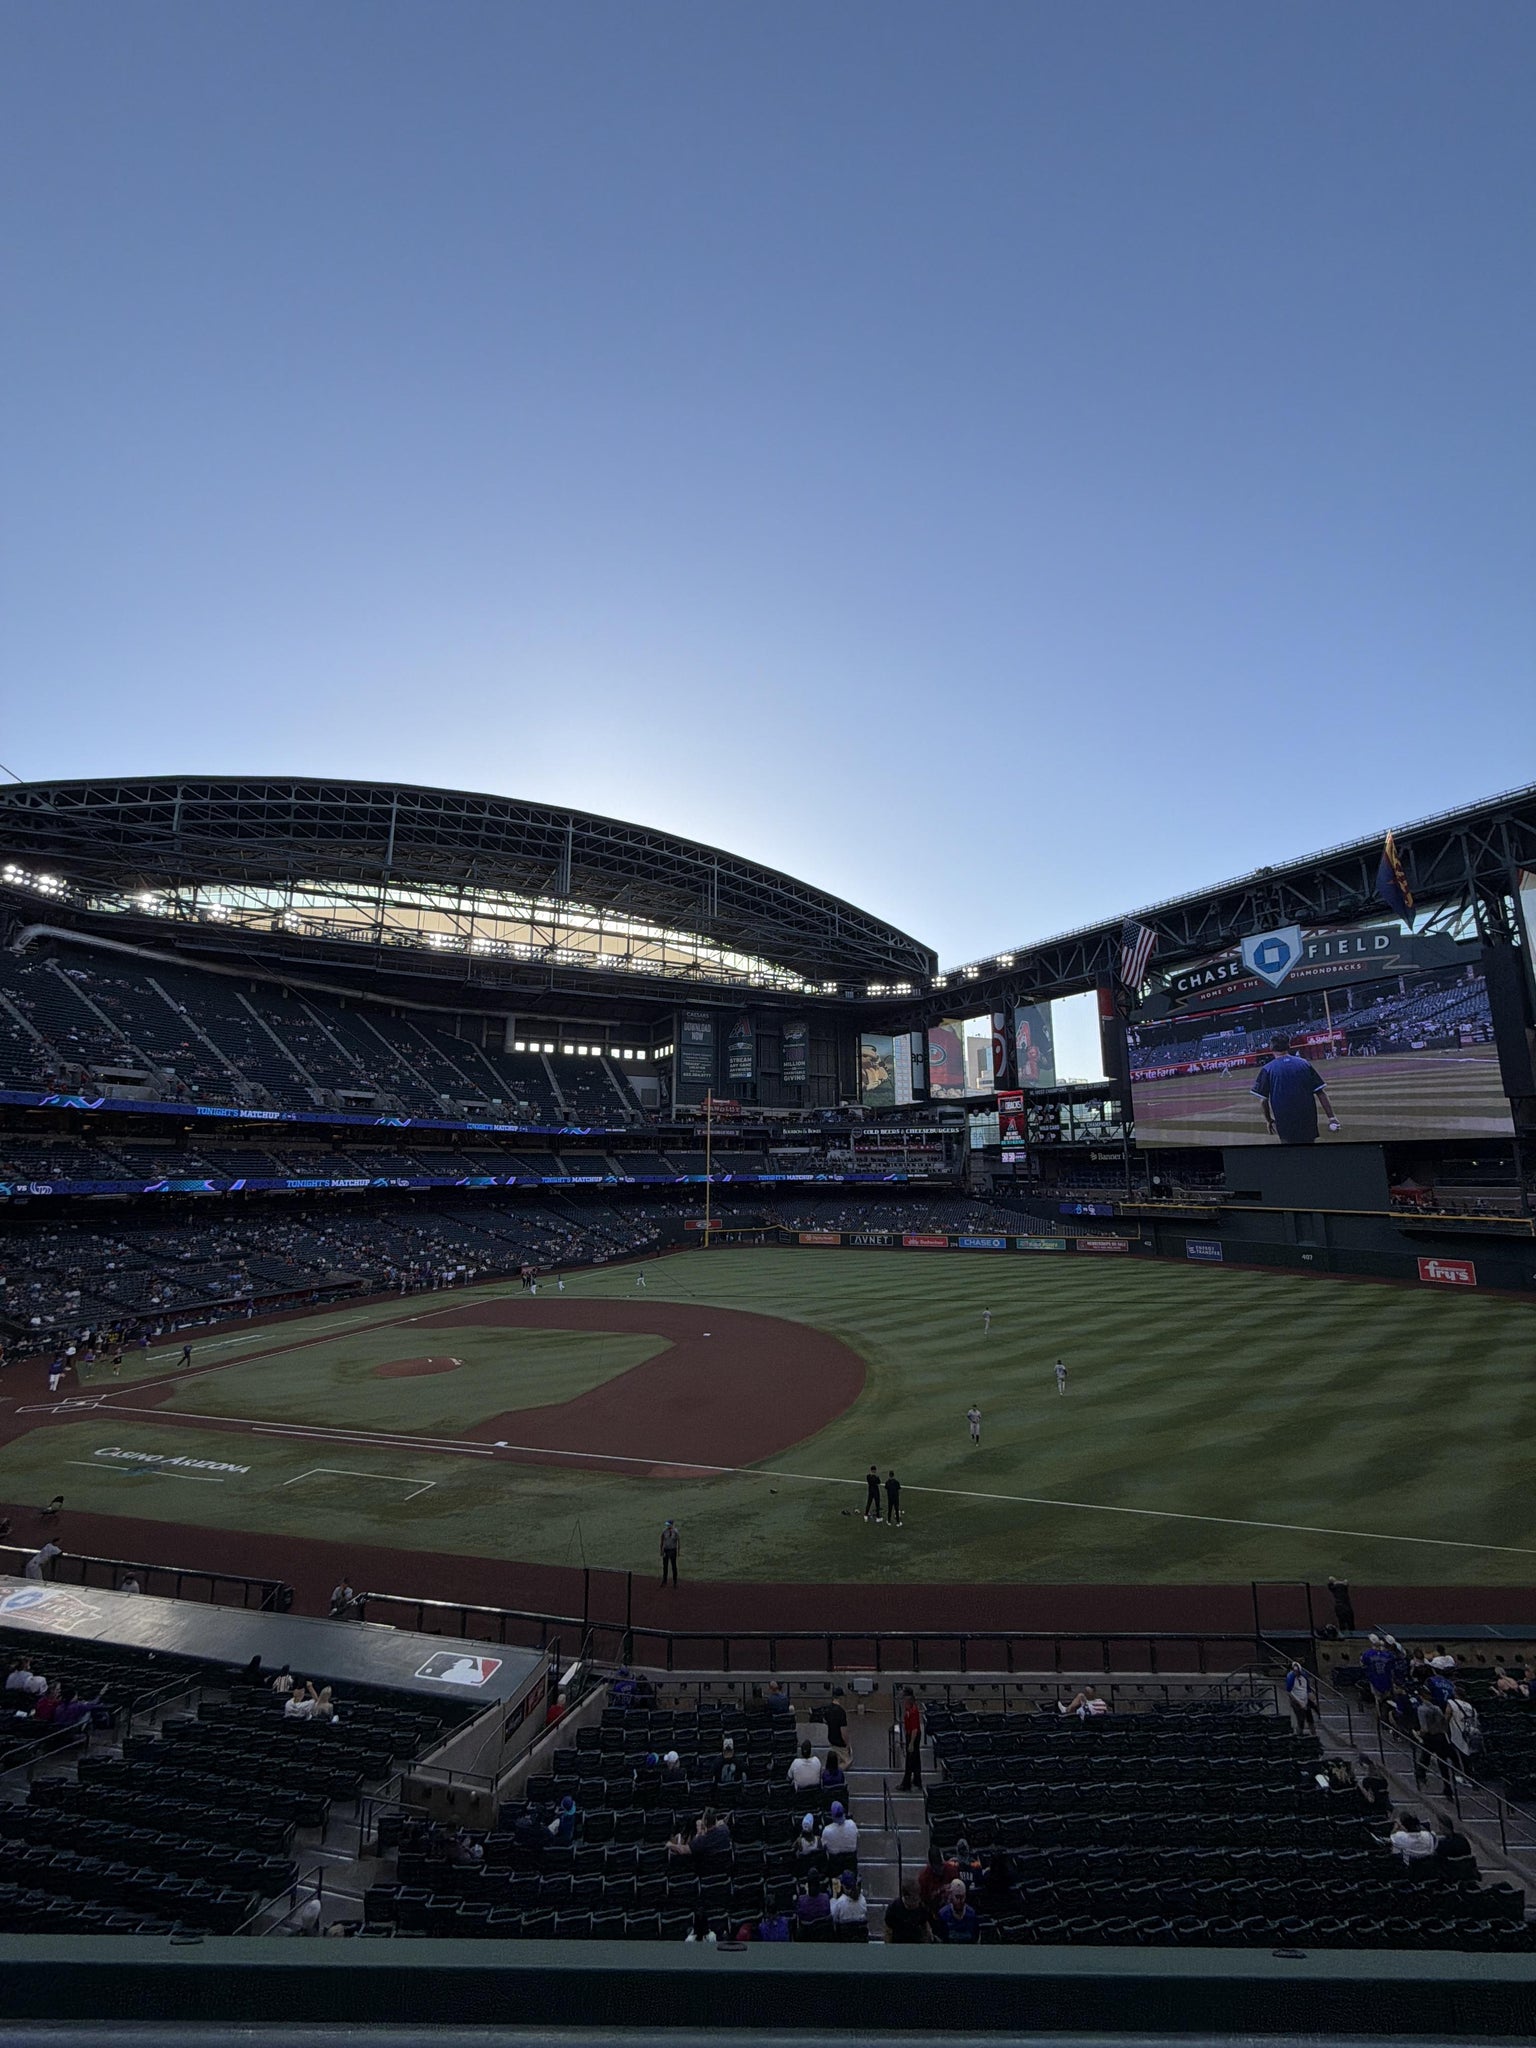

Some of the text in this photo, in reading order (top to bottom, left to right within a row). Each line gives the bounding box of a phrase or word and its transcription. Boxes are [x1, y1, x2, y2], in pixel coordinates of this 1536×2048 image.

[1177, 935, 1391, 992] CHASE FIELD
[1200, 963, 1363, 1000] HOME OF THE DIAMONDBACKS
[691, 1032, 704, 1041] NOW
[196, 1106, 280, 1120] TONIGHT'S MATCHUP
[286, 1179, 331, 1188] TONIGHT'S
[331, 1178, 371, 1188] MATCHUP
[854, 1235, 889, 1244] AVNET
[964, 1240, 992, 1248] CHASE
[1424, 1260, 1469, 1281] fry's
[94, 1446, 252, 1474] CASINO ARIZONA
